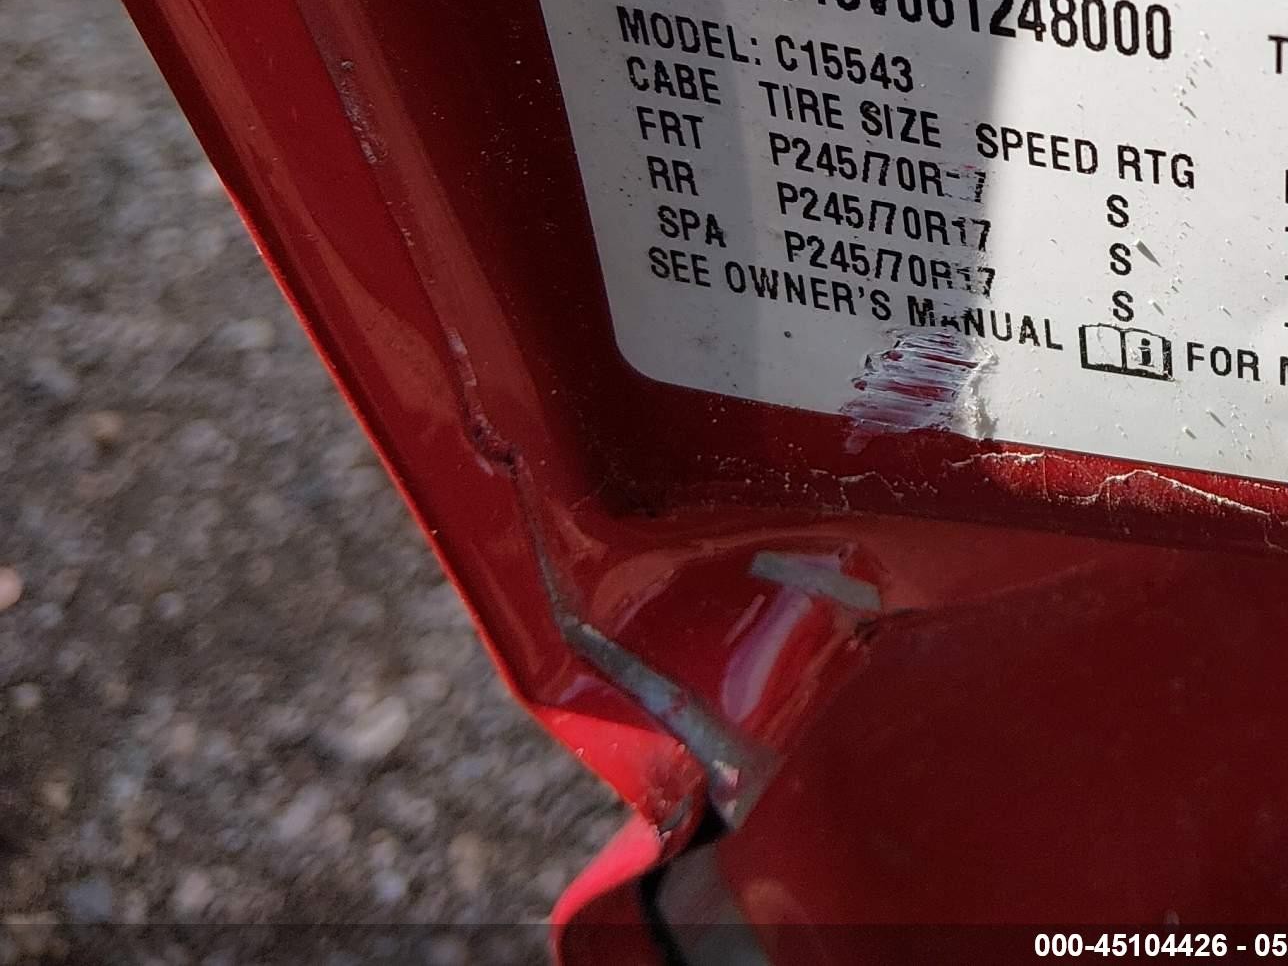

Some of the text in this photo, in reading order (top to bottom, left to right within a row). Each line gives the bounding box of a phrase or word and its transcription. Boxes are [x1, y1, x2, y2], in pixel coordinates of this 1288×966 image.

[616, 5, 914, 94] MODEL: C15543
[627, 57, 942, 149] CABE TIRE SIZE
[637, 106, 704, 151] FRT
[648, 156, 699, 197] RR
[769, 131, 987, 204] P245/70R7
[975, 123, 1196, 191] SPEED RTG
[658, 205, 727, 249] SPA
[776, 181, 992, 252] P245/70R17
[1106, 194, 1130, 228] S
[1108, 242, 1132, 276] S
[647, 246, 710, 289] SEE
[724, 262, 893, 321] OWNER'S
[1186, 341, 1261, 382] FOR
[1111, 290, 1135, 324] S
